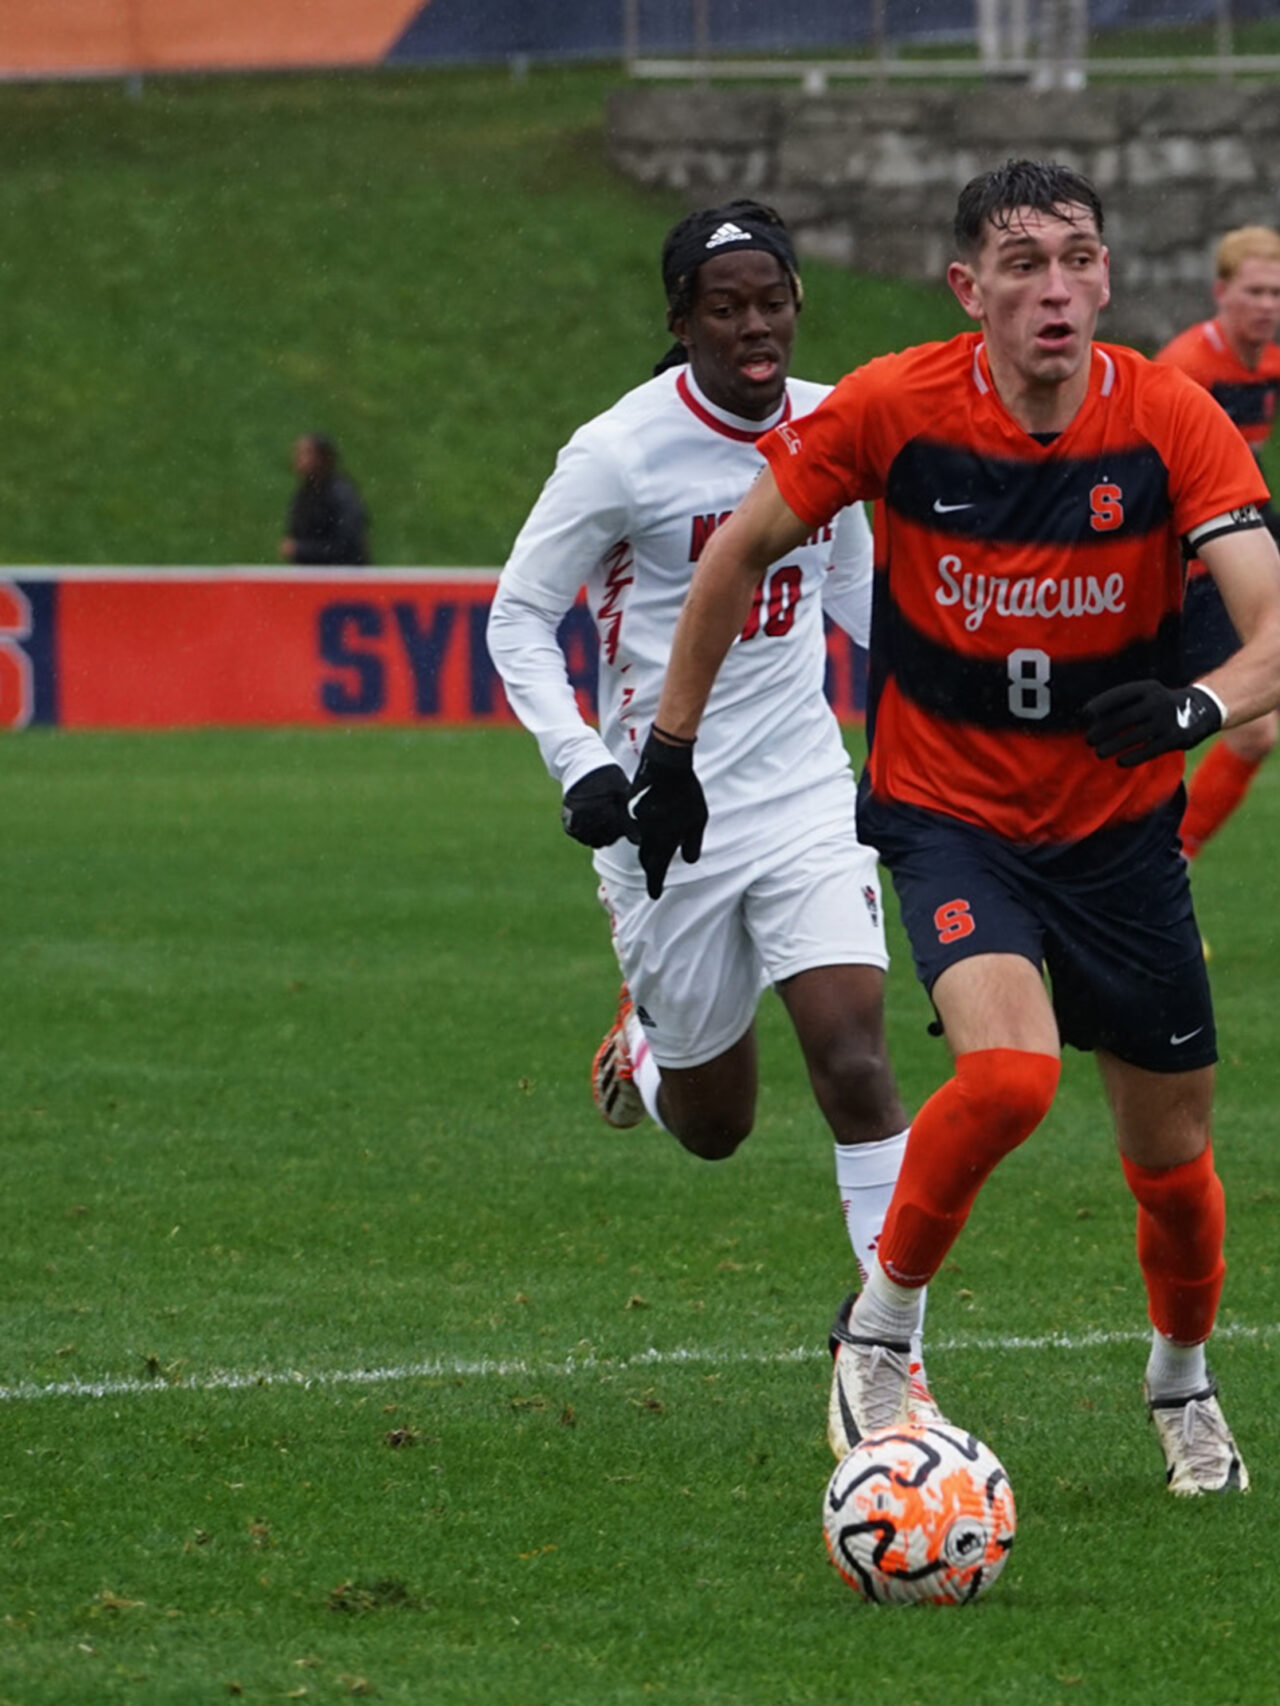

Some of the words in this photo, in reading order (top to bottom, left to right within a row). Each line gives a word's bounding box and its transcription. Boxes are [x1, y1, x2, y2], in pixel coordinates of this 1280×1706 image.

[1090, 484, 1124, 532] S
[935, 554, 1126, 632] Syracuse
[1007, 648, 1052, 720] 8
[934, 898, 976, 944] S
